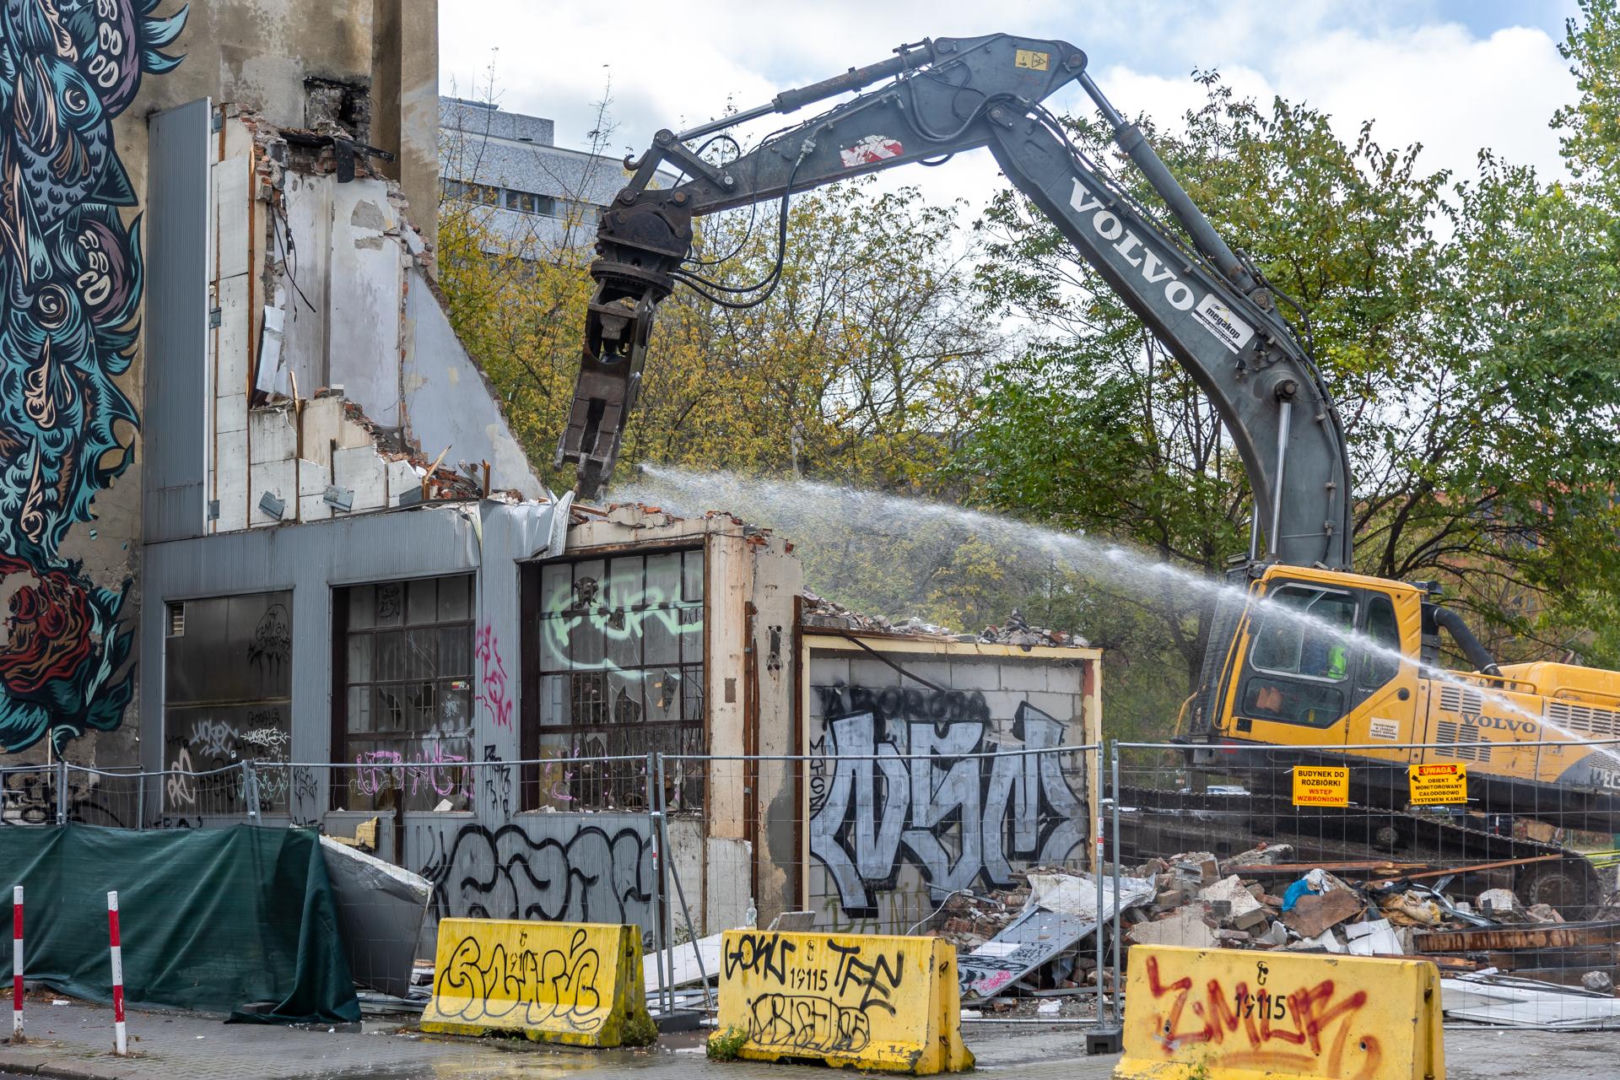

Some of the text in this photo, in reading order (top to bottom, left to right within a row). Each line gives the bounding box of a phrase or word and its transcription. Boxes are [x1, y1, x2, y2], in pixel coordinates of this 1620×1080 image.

[1069, 177, 1194, 311] VOLVO
[1205, 307, 1241, 339] megakop
[1461, 712, 1537, 734] VOLVO
[1298, 770, 1332, 778] BUDYNEK
[1423, 766, 1452, 775] UWAGA
[1297, 795, 1344, 803] WZBRONIONY
[790, 967, 828, 991] 19115
[1234, 993, 1286, 1020] 19115
